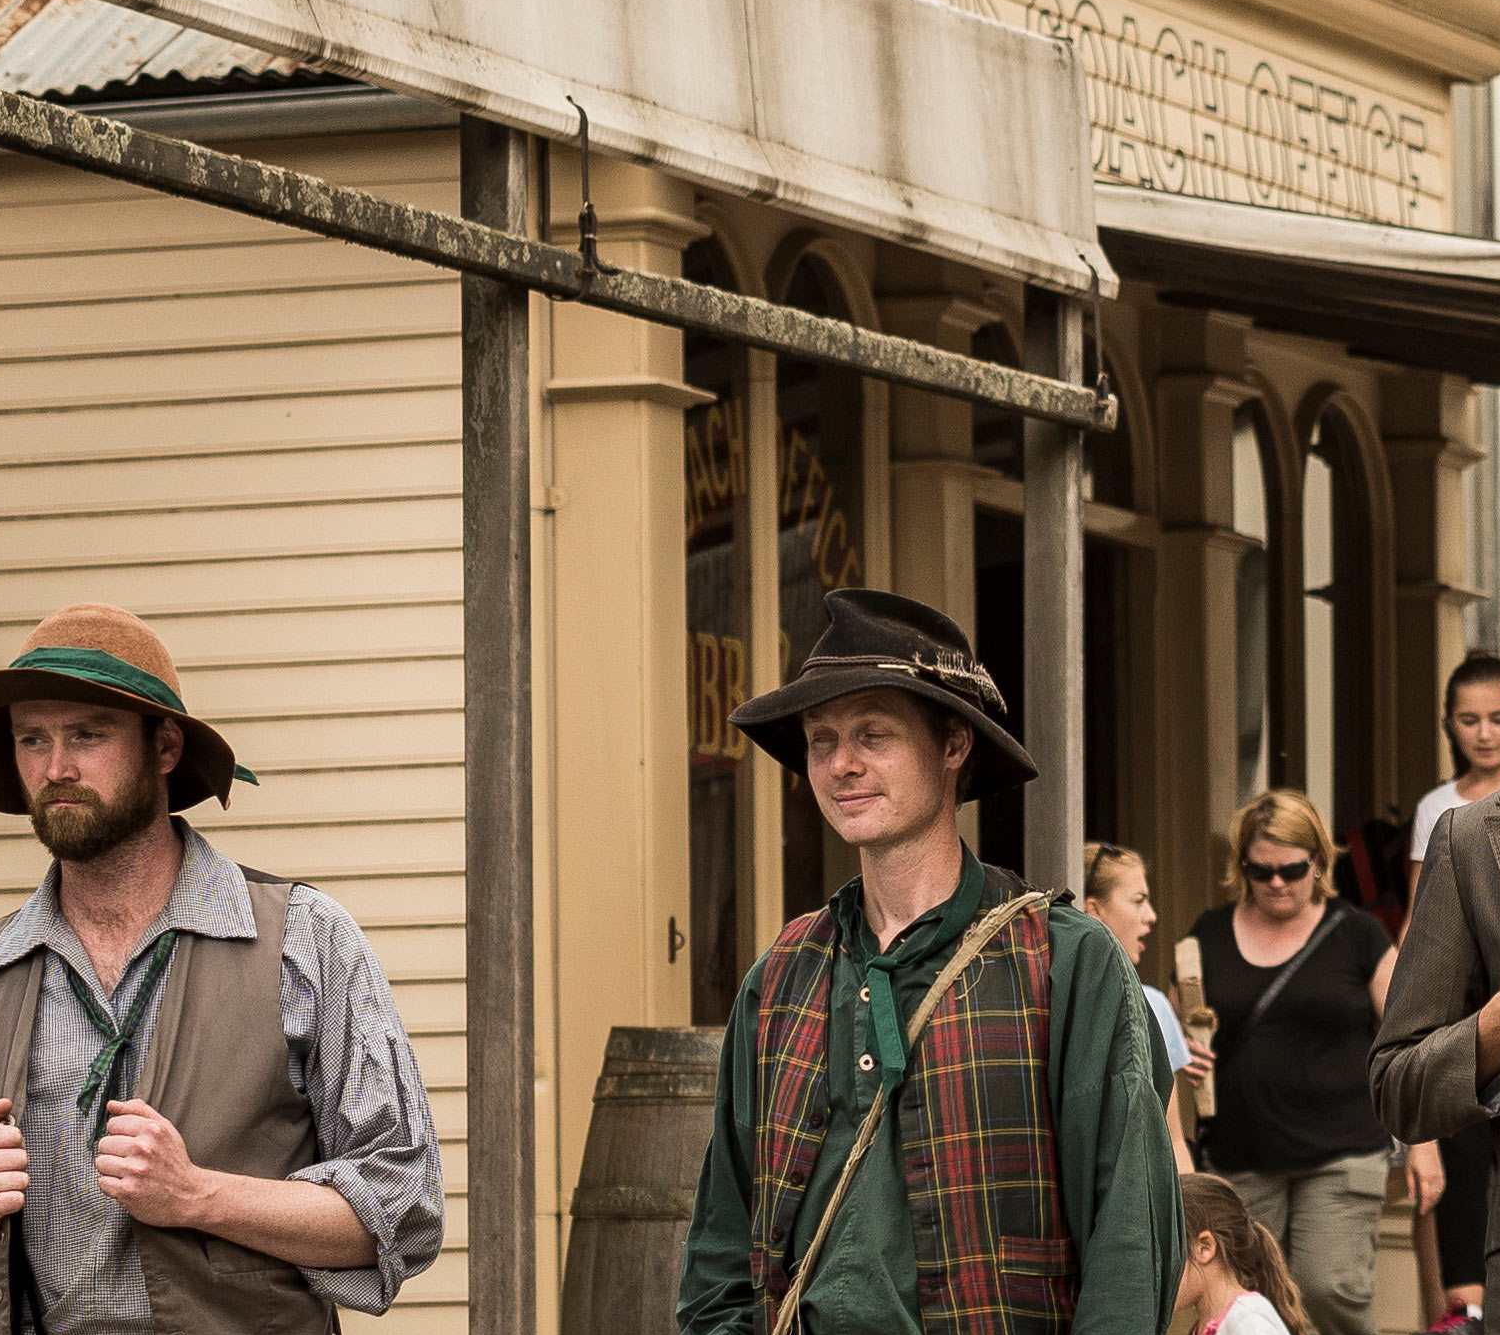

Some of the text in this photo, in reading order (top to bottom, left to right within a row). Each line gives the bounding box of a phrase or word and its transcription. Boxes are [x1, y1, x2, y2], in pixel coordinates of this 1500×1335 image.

[1245, 62, 1428, 230] OFFICE
[687, 398, 861, 588] ACH FFICE
[689, 631, 746, 759] BB
